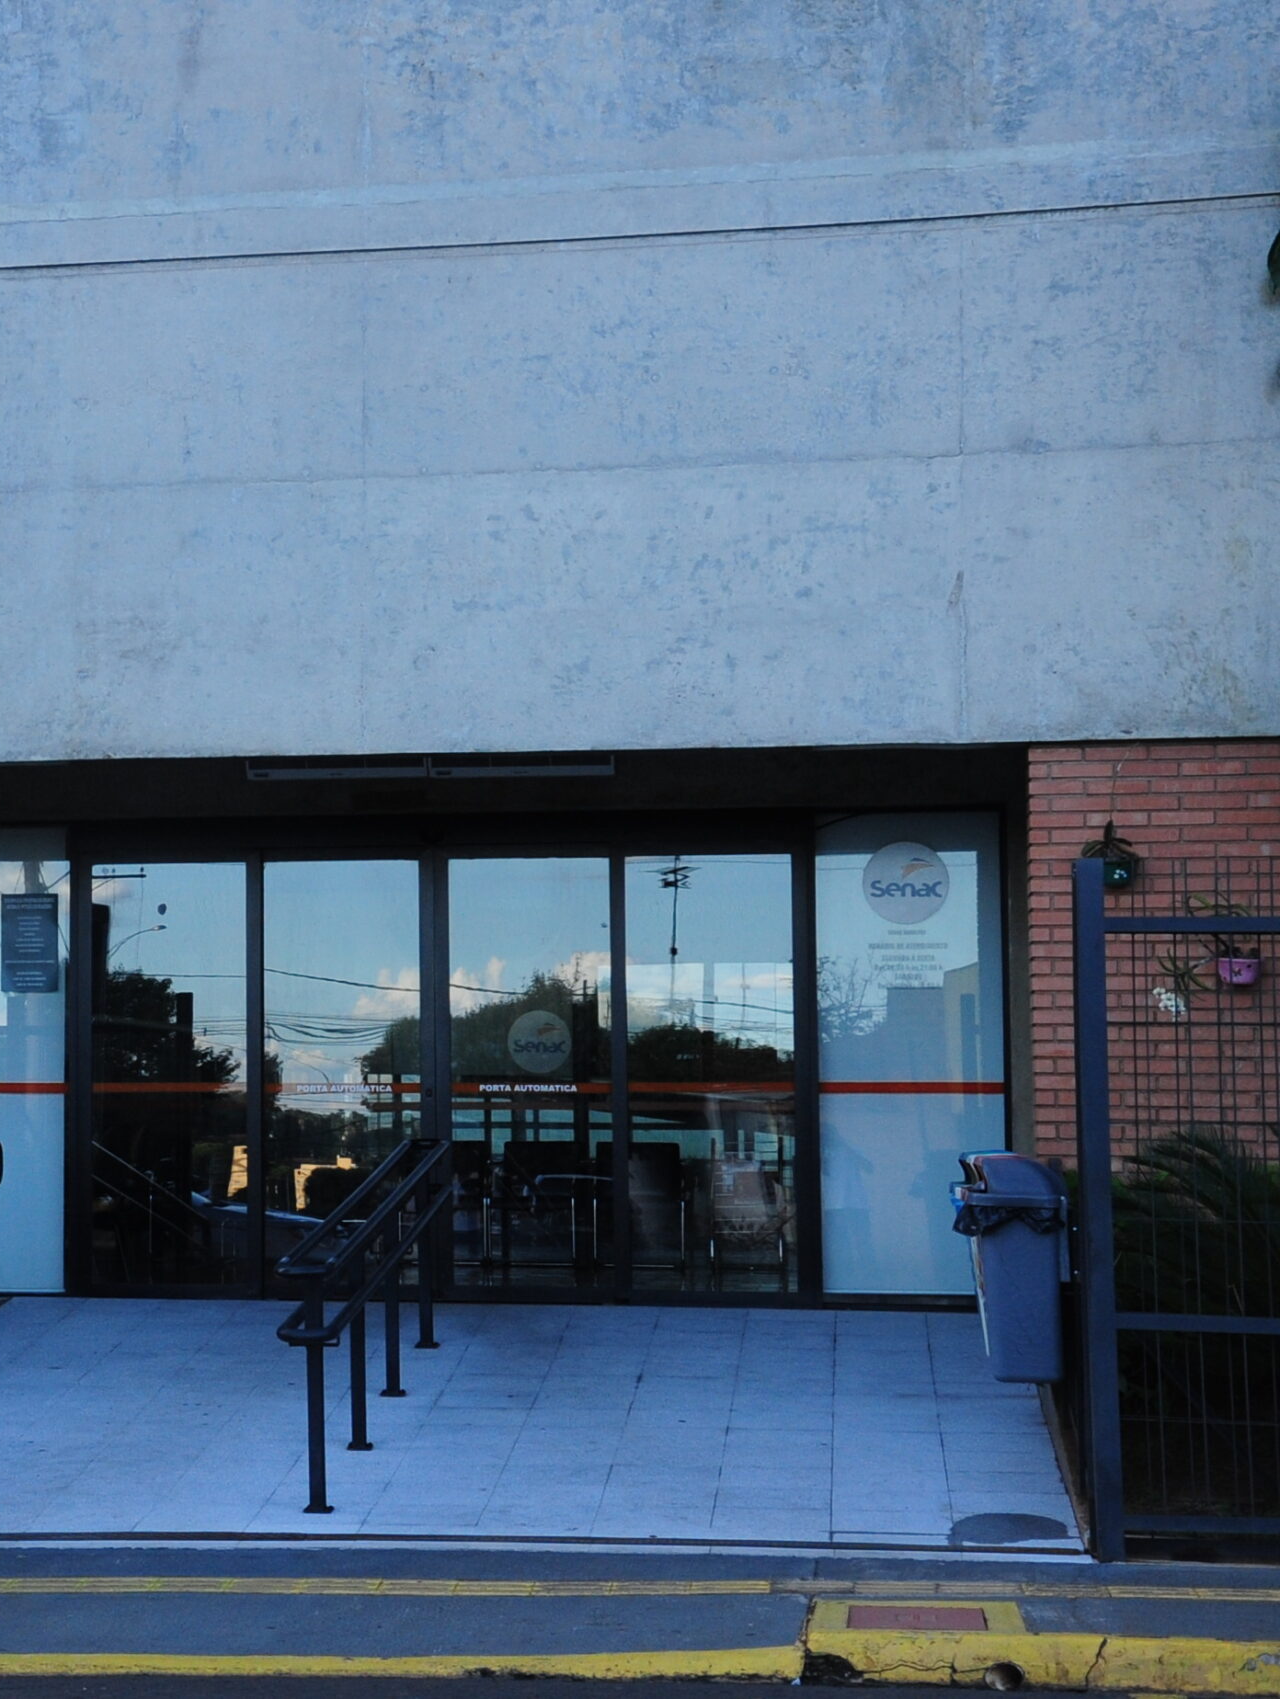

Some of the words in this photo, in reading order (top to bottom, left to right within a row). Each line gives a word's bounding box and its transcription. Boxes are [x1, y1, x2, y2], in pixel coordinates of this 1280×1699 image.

[870, 880, 943, 898] Senac
[513, 1039, 566, 1054] Senac
[297, 1084, 328, 1092] PORTA
[479, 1084, 512, 1092] PORTA
